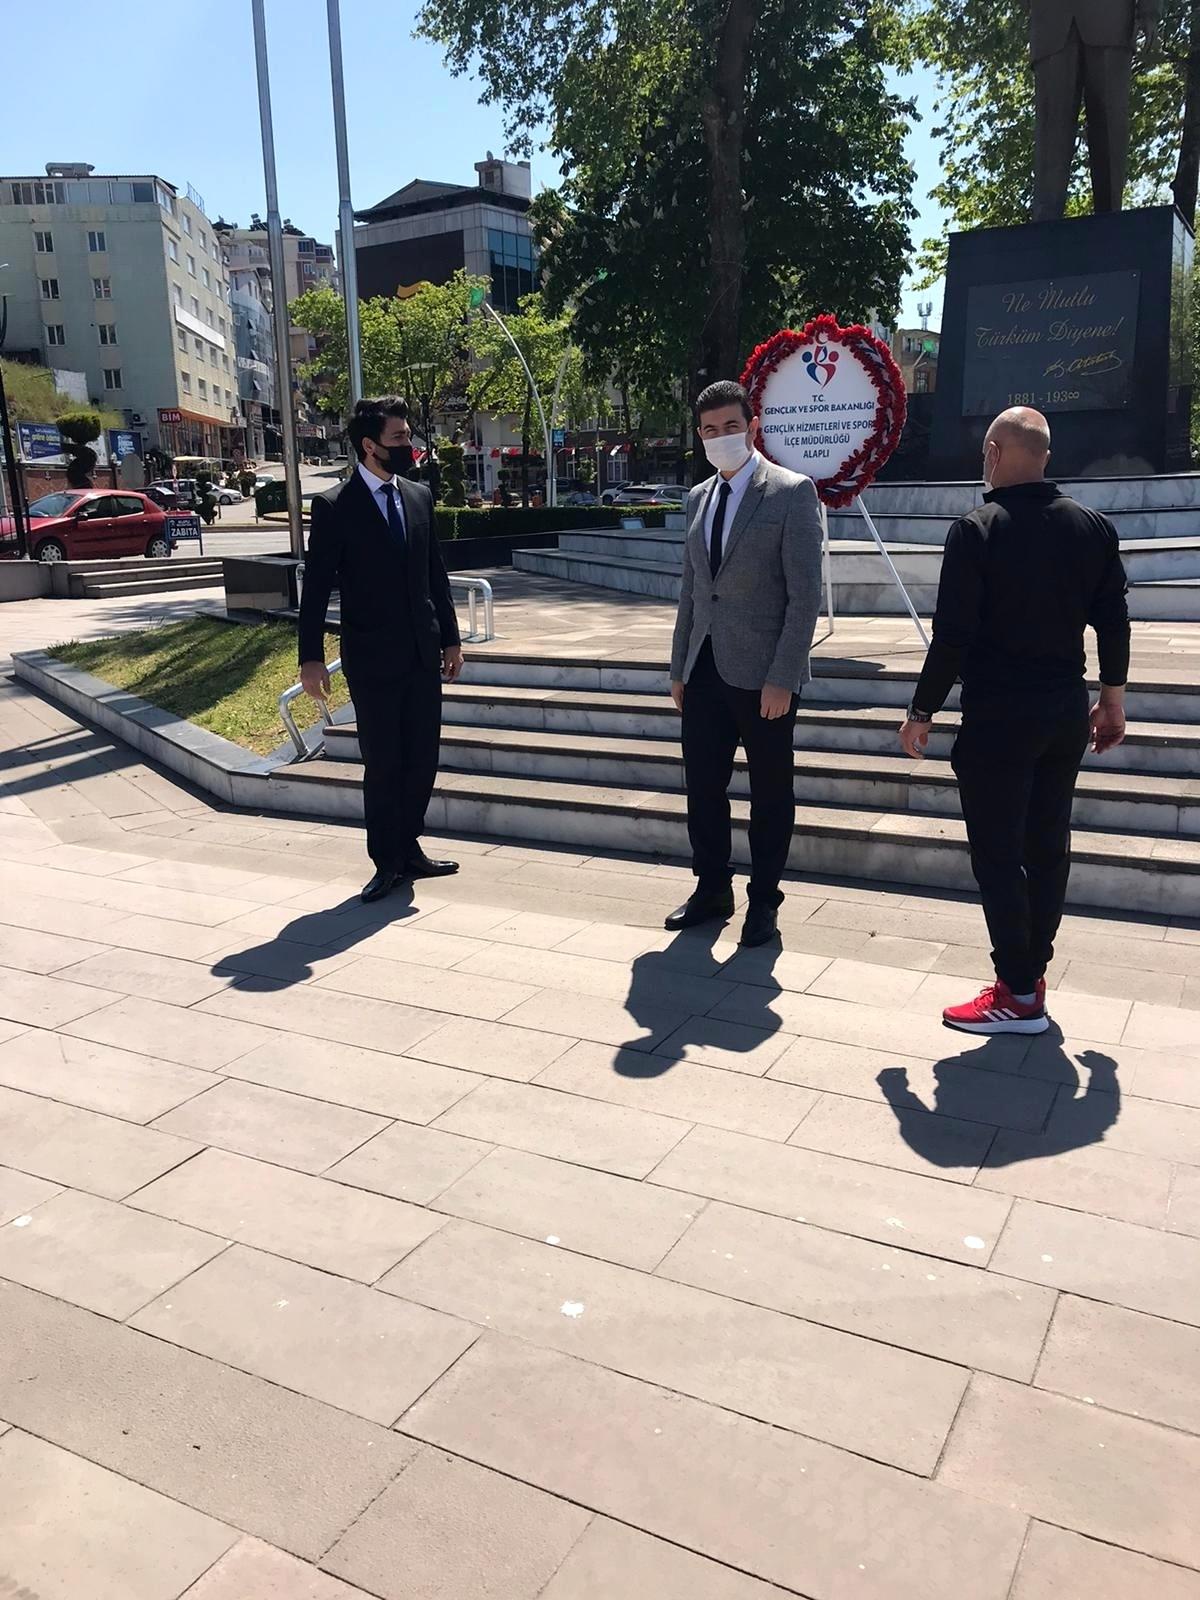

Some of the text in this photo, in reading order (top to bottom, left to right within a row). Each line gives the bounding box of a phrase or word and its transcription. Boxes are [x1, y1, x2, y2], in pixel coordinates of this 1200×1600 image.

[1038, 285, 1098, 310] Mutlu
[798, 404, 808, 414] VE
[809, 403, 829, 413] SPOR
[764, 419, 873, 434] GENÇLİK HİZMETLERİ VE SPOR
[784, 433, 850, 447] İLÇE MÜDÜRLÜĞÜ
[803, 449, 830, 459] ALAPLI
